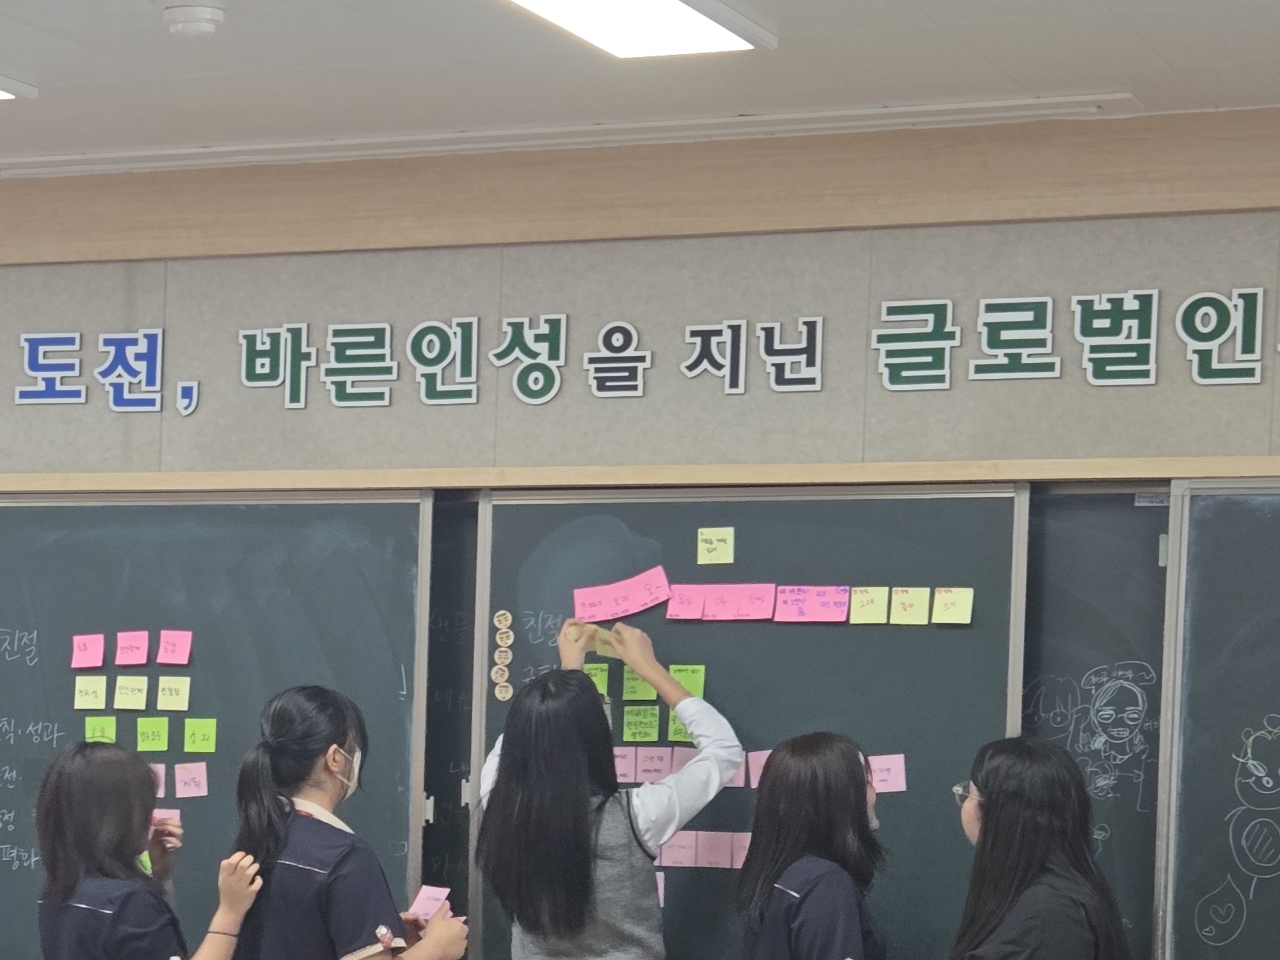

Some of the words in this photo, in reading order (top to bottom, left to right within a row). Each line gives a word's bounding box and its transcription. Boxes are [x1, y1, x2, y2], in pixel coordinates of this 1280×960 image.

[14, 328, 200, 417] 도전,
[680, 316, 824, 394] 지닌
[871, 287, 1280, 391] 글로벌인
